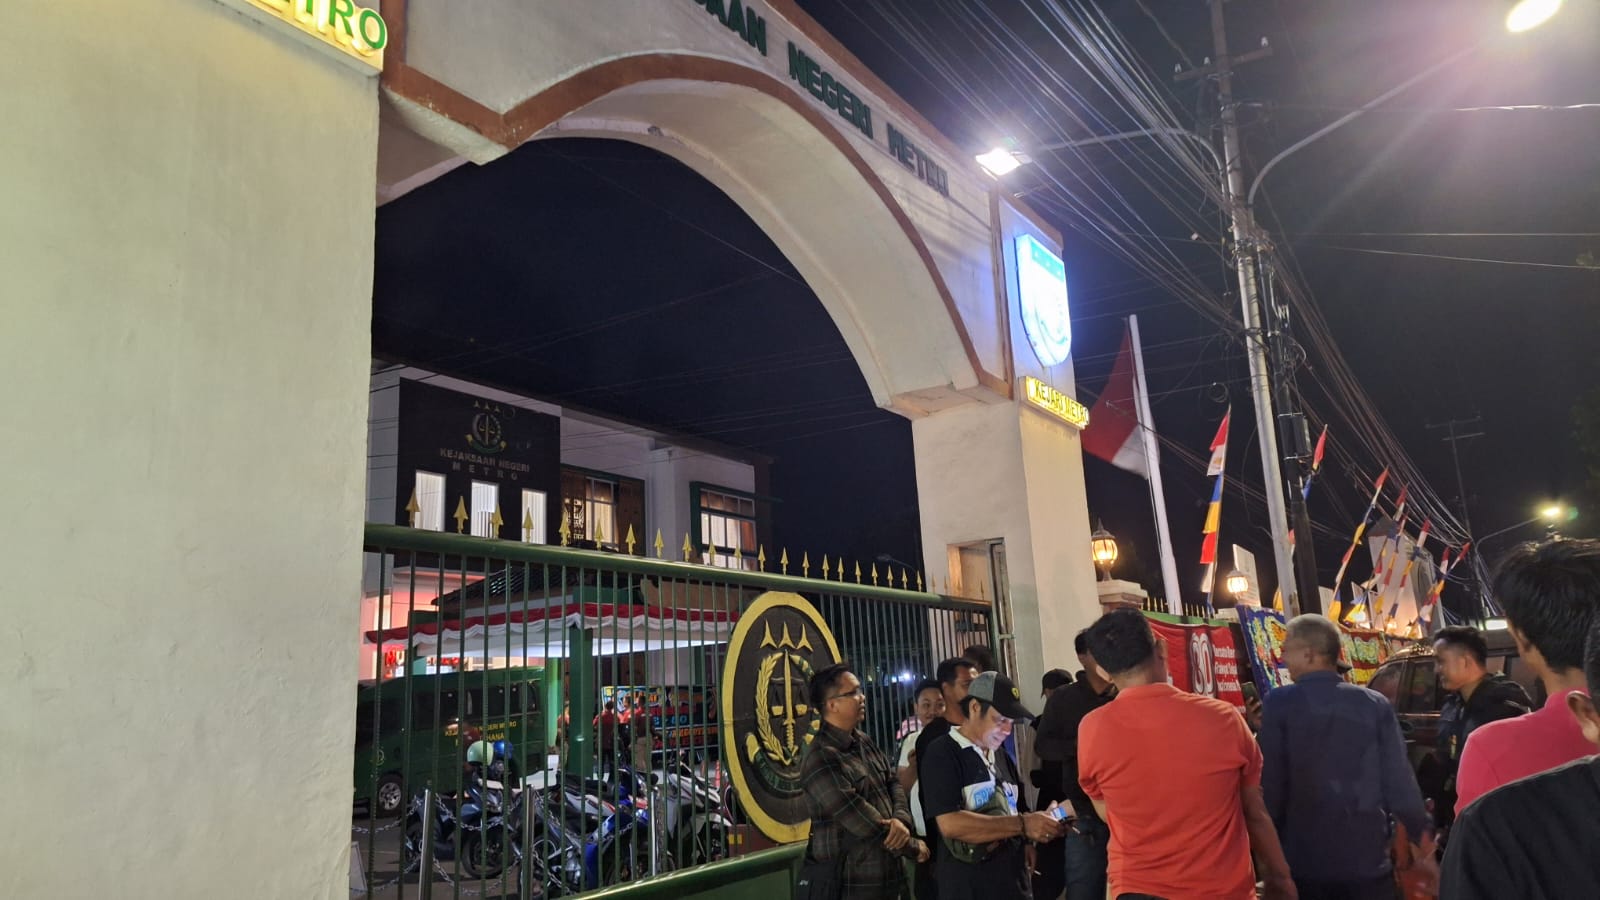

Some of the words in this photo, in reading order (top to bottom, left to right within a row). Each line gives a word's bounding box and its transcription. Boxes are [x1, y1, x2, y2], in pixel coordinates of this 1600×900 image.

[787, 40, 873, 140] NEGERI
[886, 121, 950, 198] METRO
[440, 448, 495, 466] KEJAKSAAN
[498, 459, 530, 473] NEGERI
[1191, 631, 1215, 698] 80
